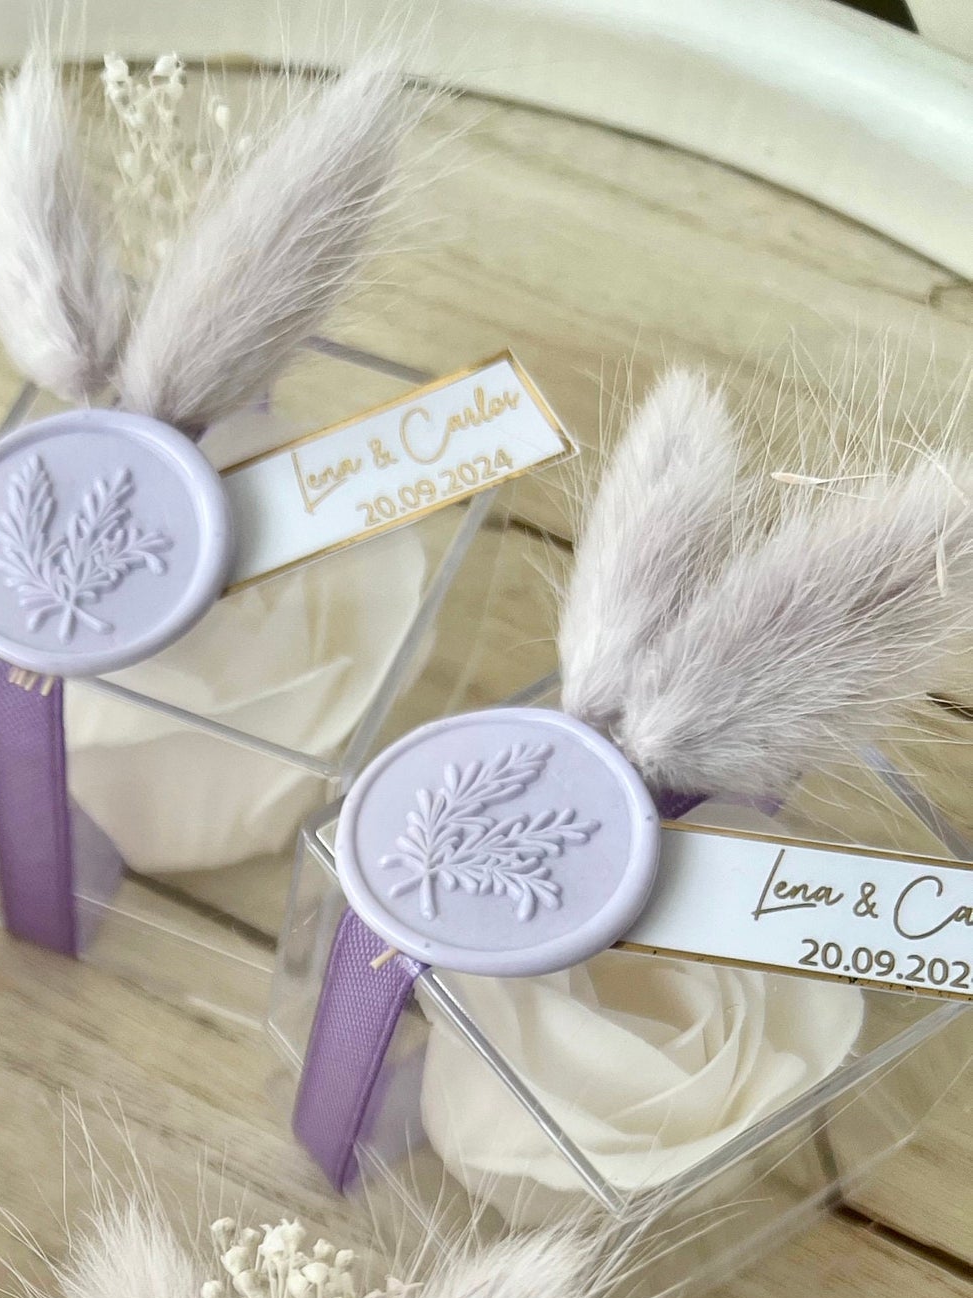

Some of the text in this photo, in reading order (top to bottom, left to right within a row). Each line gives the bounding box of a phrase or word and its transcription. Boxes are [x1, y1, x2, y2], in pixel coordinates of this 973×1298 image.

[291, 386, 520, 515] Lena & Carlos
[356, 448, 514, 527] 20.09.2024
[751, 848, 844, 921] Lena
[852, 882, 879, 919] &
[798, 938, 973, 989] 20.09.202
